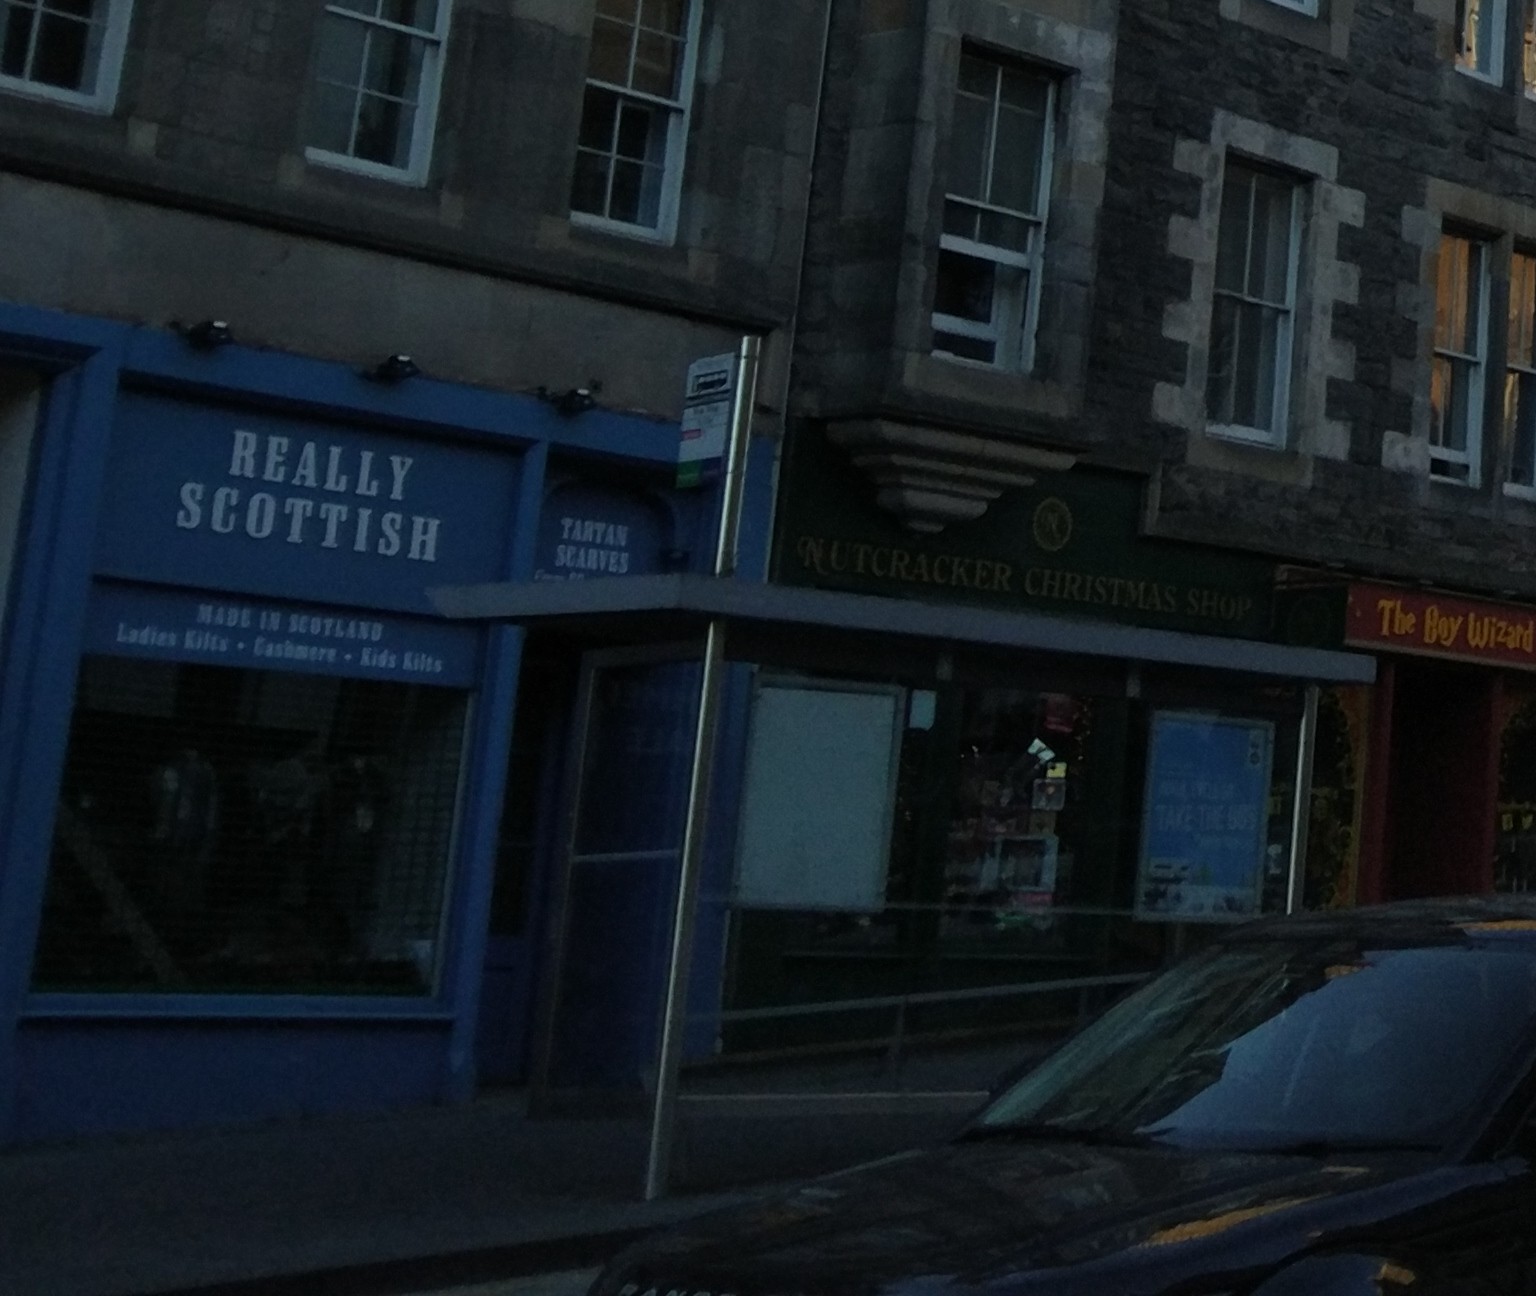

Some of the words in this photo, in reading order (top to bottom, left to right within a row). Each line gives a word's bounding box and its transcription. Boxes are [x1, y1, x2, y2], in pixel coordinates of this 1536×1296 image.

[228, 428, 414, 501] REALLY
[175, 481, 442, 563] SCOTTISH
[560, 517, 630, 548] TARTAN
[555, 544, 630, 574] SCARVES
[798, 535, 1012, 593] NUTCRACKER
[1023, 567, 1178, 615] CHRISTMAS
[1186, 587, 1254, 622] SHOP
[196, 603, 252, 629] MADE
[259, 610, 282, 633] IN
[287, 613, 385, 642] SCOTLAND
[1377, 599, 1418, 638] The
[1422, 605, 1465, 648] Boy
[1466, 611, 1536, 654] Wizard
